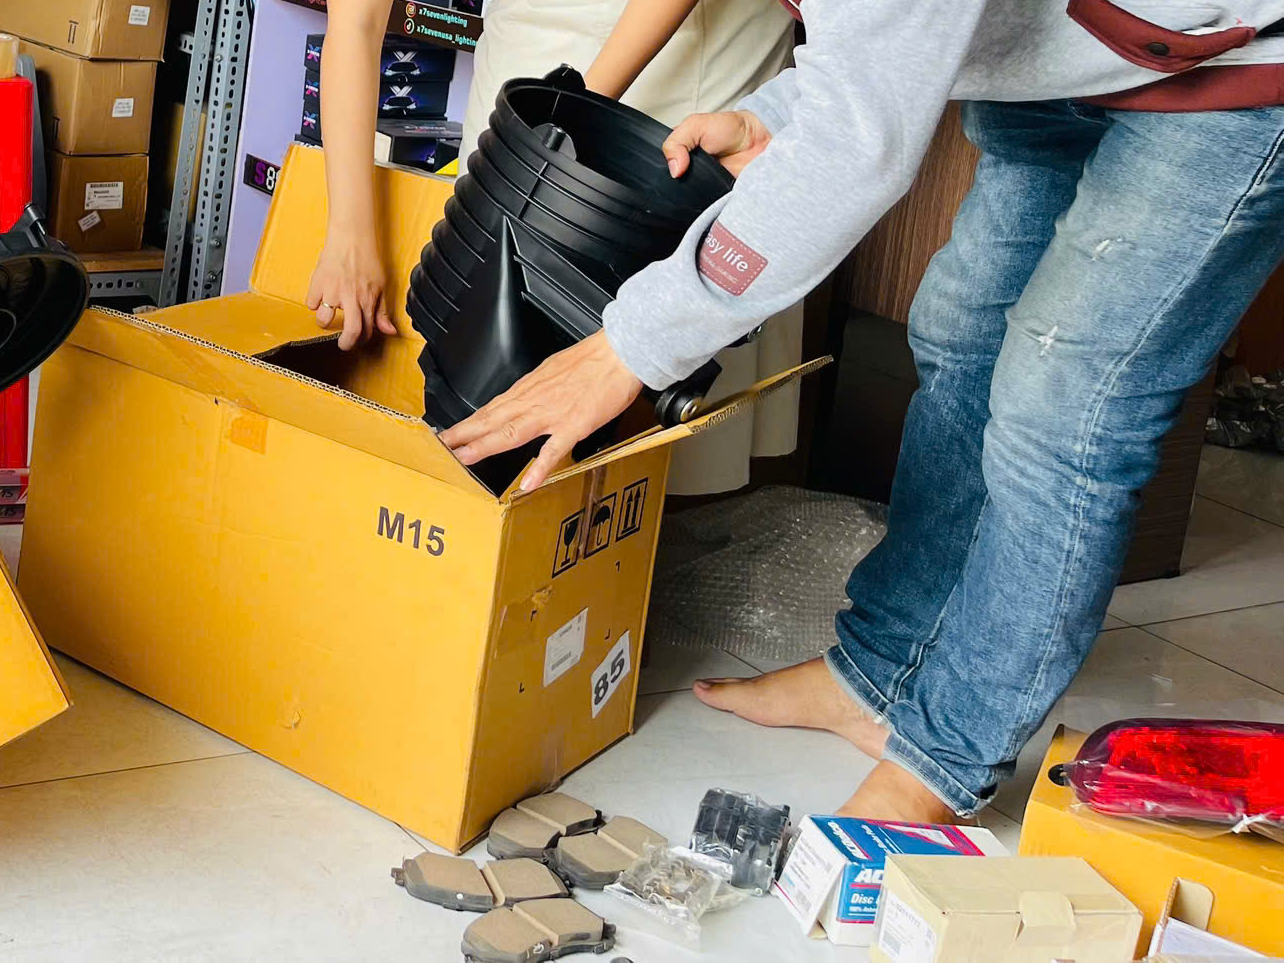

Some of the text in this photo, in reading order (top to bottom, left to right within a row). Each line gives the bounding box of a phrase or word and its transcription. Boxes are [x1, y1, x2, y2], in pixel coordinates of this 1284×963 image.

[418, 7, 468, 27] x7sevenlighting
[417, 24, 477, 46] x7sevenusa_lightin
[253, 161, 281, 189] S8
[722, 247, 749, 272] life
[377, 505, 445, 557] M15
[594, 648, 625, 706] 85
[850, 892, 875, 905] Disc
